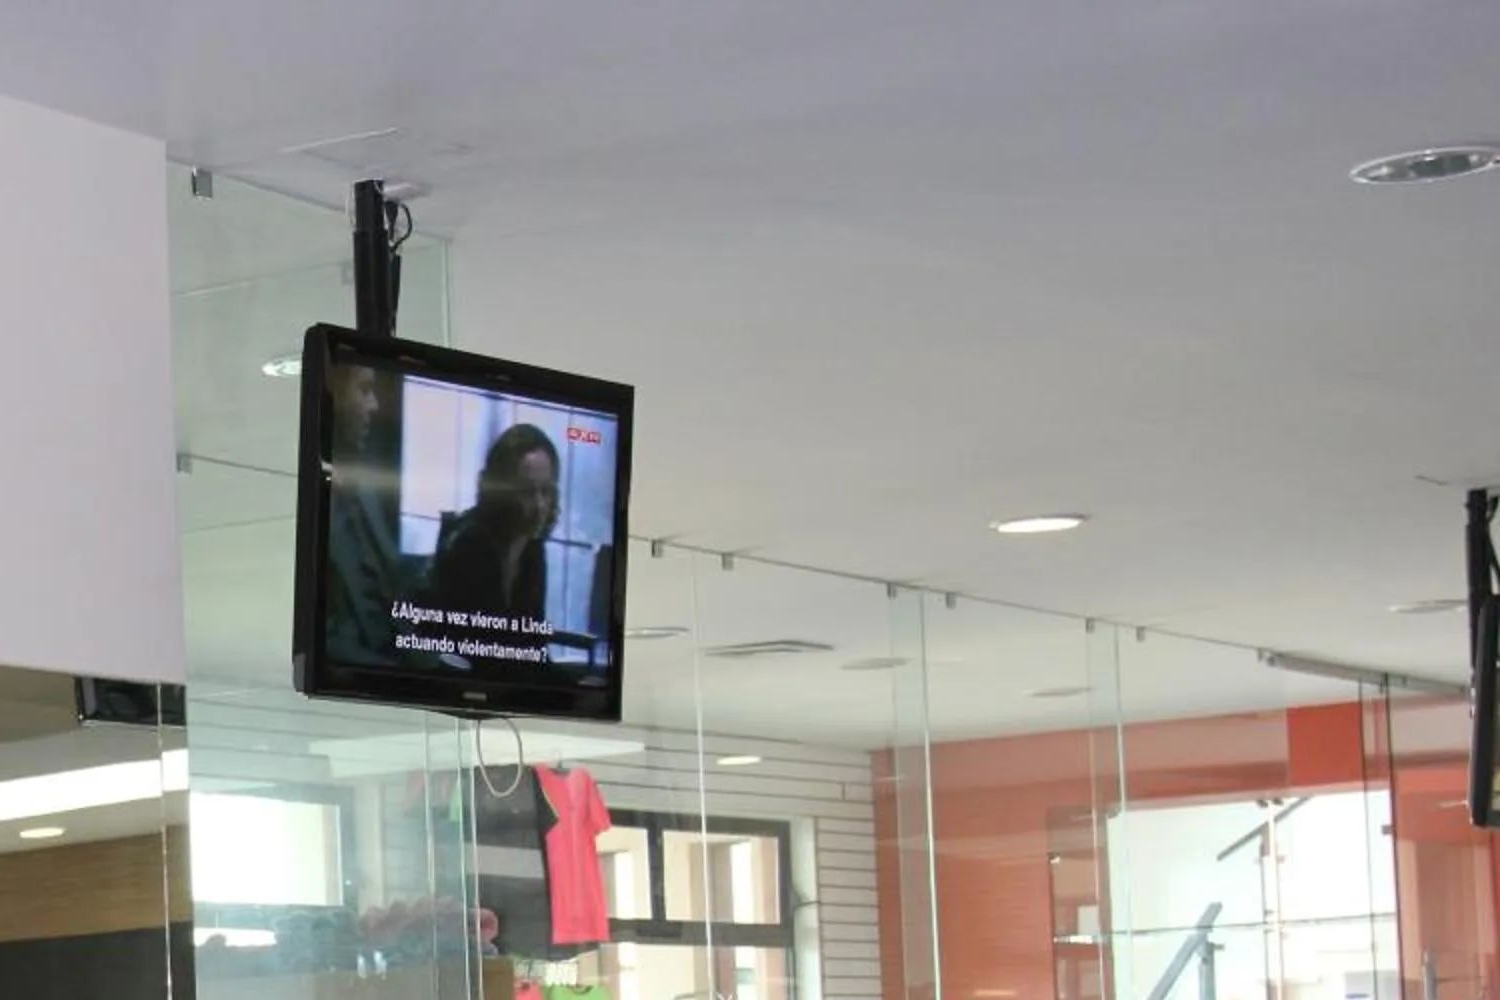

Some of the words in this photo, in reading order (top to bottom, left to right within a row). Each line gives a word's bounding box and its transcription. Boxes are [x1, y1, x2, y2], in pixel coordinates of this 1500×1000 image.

[391, 601, 443, 625] ¿Alguna
[446, 611, 468, 627] vez
[469, 610, 507, 631] vieron
[511, 618, 519, 632] a
[521, 616, 553, 636] Linda
[395, 633, 455, 654] actuando
[457, 637, 548, 664] violentamente?
